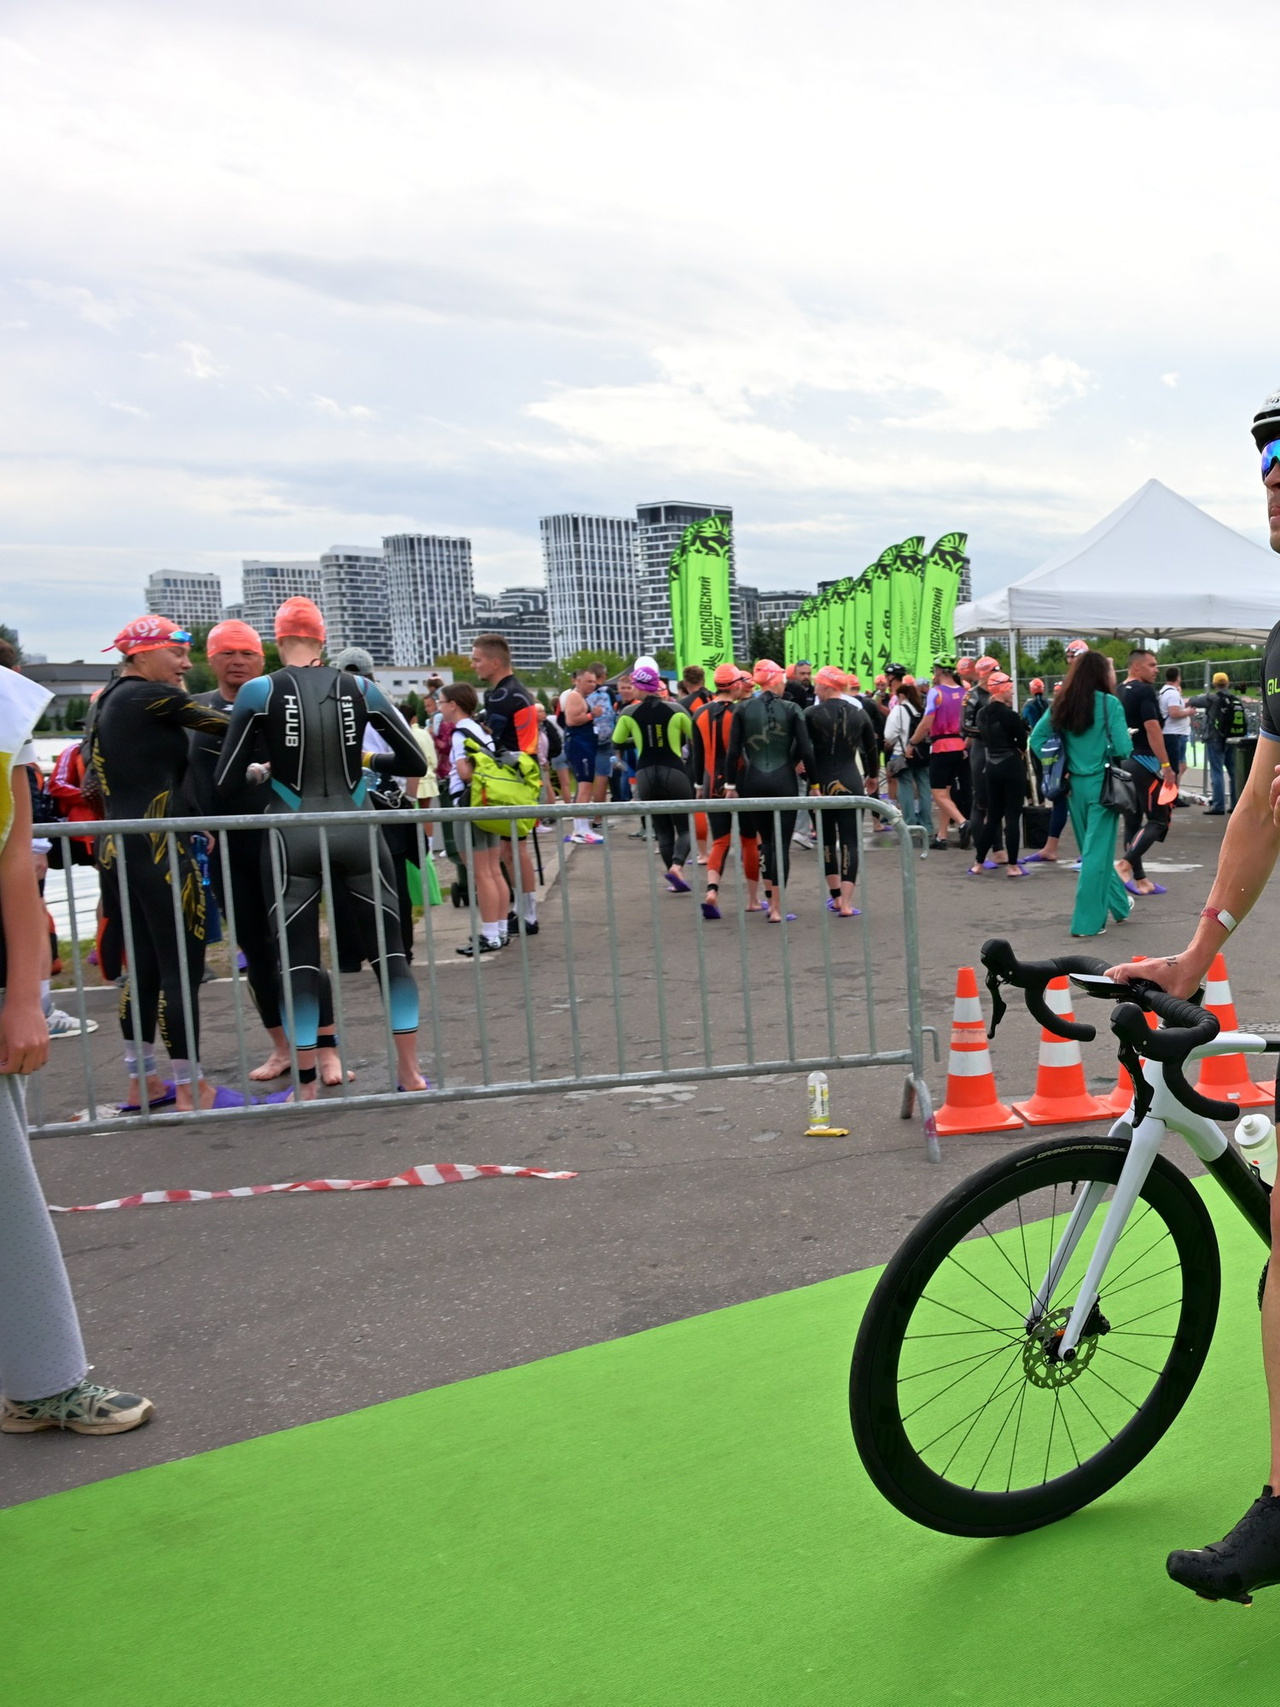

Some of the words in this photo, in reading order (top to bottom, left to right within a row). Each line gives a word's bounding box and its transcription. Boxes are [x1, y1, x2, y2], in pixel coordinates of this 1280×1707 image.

[699, 576, 714, 647] МОСКОВСКИЙ
[930, 587, 943, 655] МОСКОВСКИЙ
[284, 695, 299, 748] HUUB
